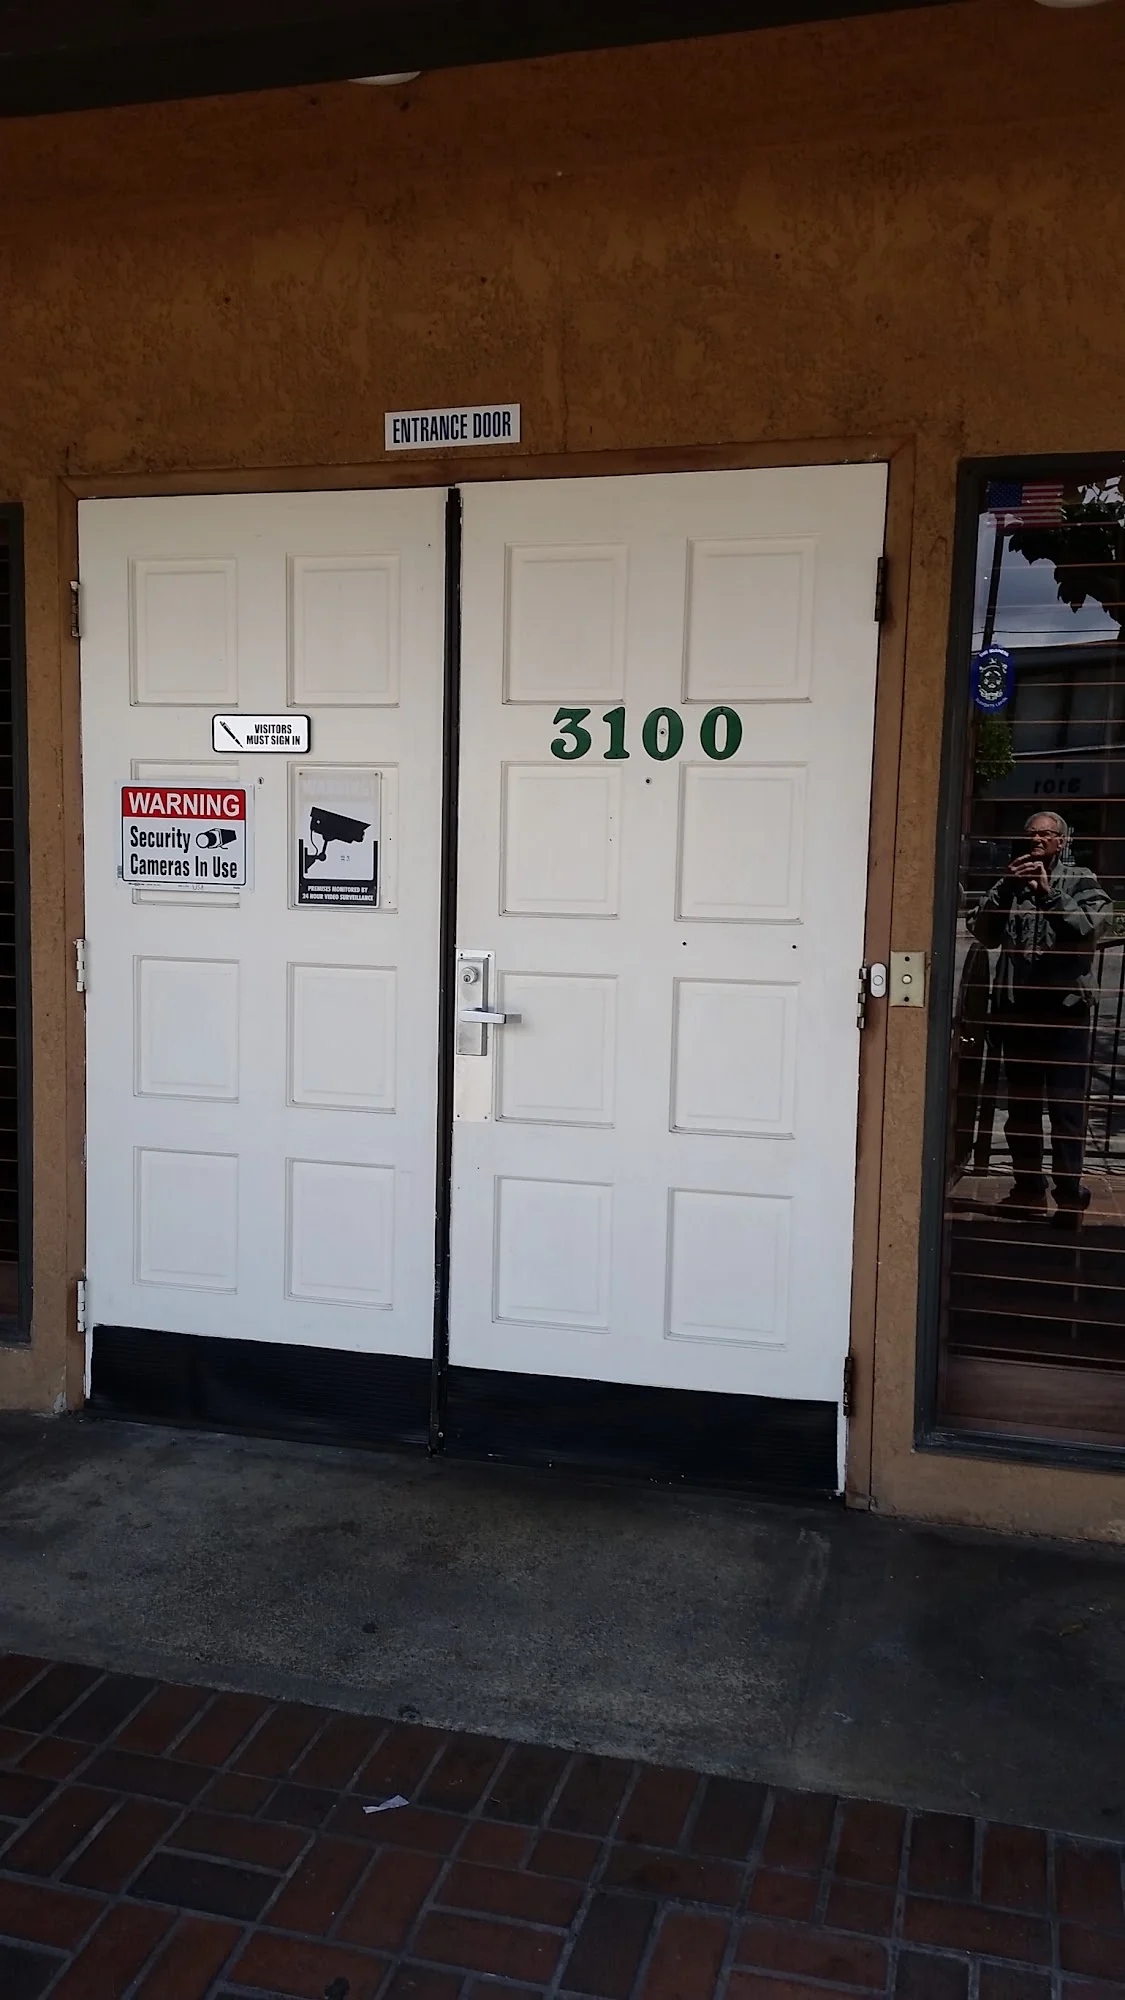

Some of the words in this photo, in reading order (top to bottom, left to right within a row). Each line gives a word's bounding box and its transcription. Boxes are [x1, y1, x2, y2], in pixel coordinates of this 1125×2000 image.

[393, 414, 467, 443] ENTRANCE
[473, 411, 511, 438] DOOR
[246, 735, 269, 745] MUST
[271, 735, 290, 745] SIGN
[292, 735, 301, 745] IN
[254, 724, 292, 734] VISITORS
[551, 706, 742, 761] 3100
[128, 792, 240, 817] WARNING
[130, 825, 191, 854] Security
[130, 853, 190, 877] Cameras
[195, 855, 208, 878] In
[212, 856, 238, 879] Use
